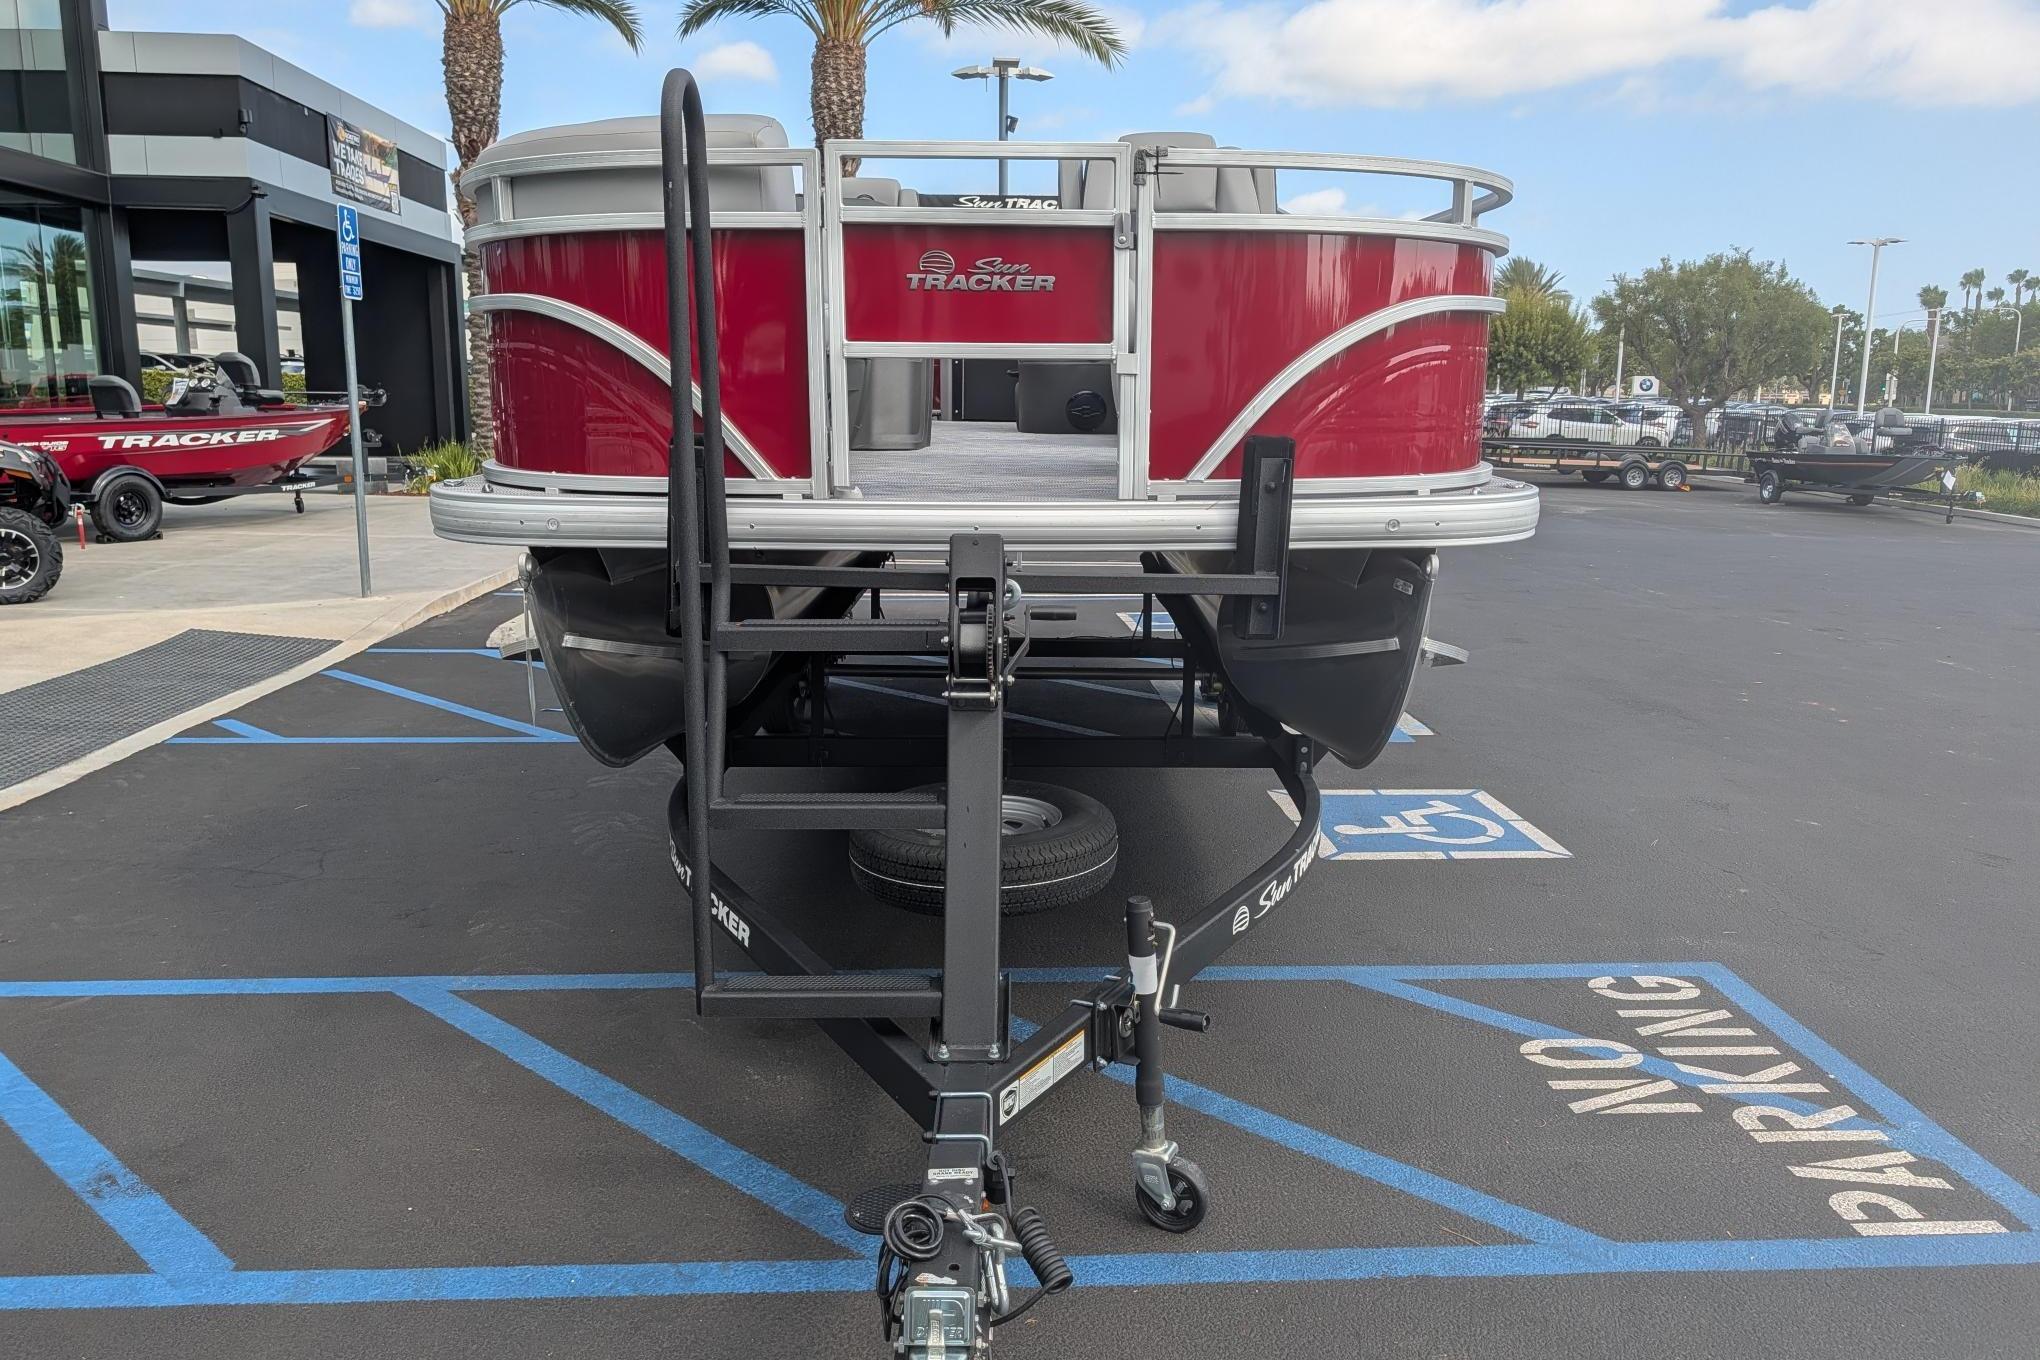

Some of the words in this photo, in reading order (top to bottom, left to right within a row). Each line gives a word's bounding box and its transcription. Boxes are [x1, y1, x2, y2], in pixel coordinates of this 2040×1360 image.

[333, 140, 347, 160] WE
[347, 147, 363, 167] TAKE
[334, 158, 365, 185] TRADES
[953, 196, 1003, 208] Sun
[1005, 197, 1060, 210] TRAC
[967, 257, 1031, 274] Sun
[906, 273, 1056, 292] TRACKER
[98, 429, 280, 449] TRACKER
[280, 482, 316, 492] TRACKER
[1254, 875, 1293, 918] Sun
[1520, 1038, 1703, 1114] NO
[1588, 976, 2009, 1236] PARKING
